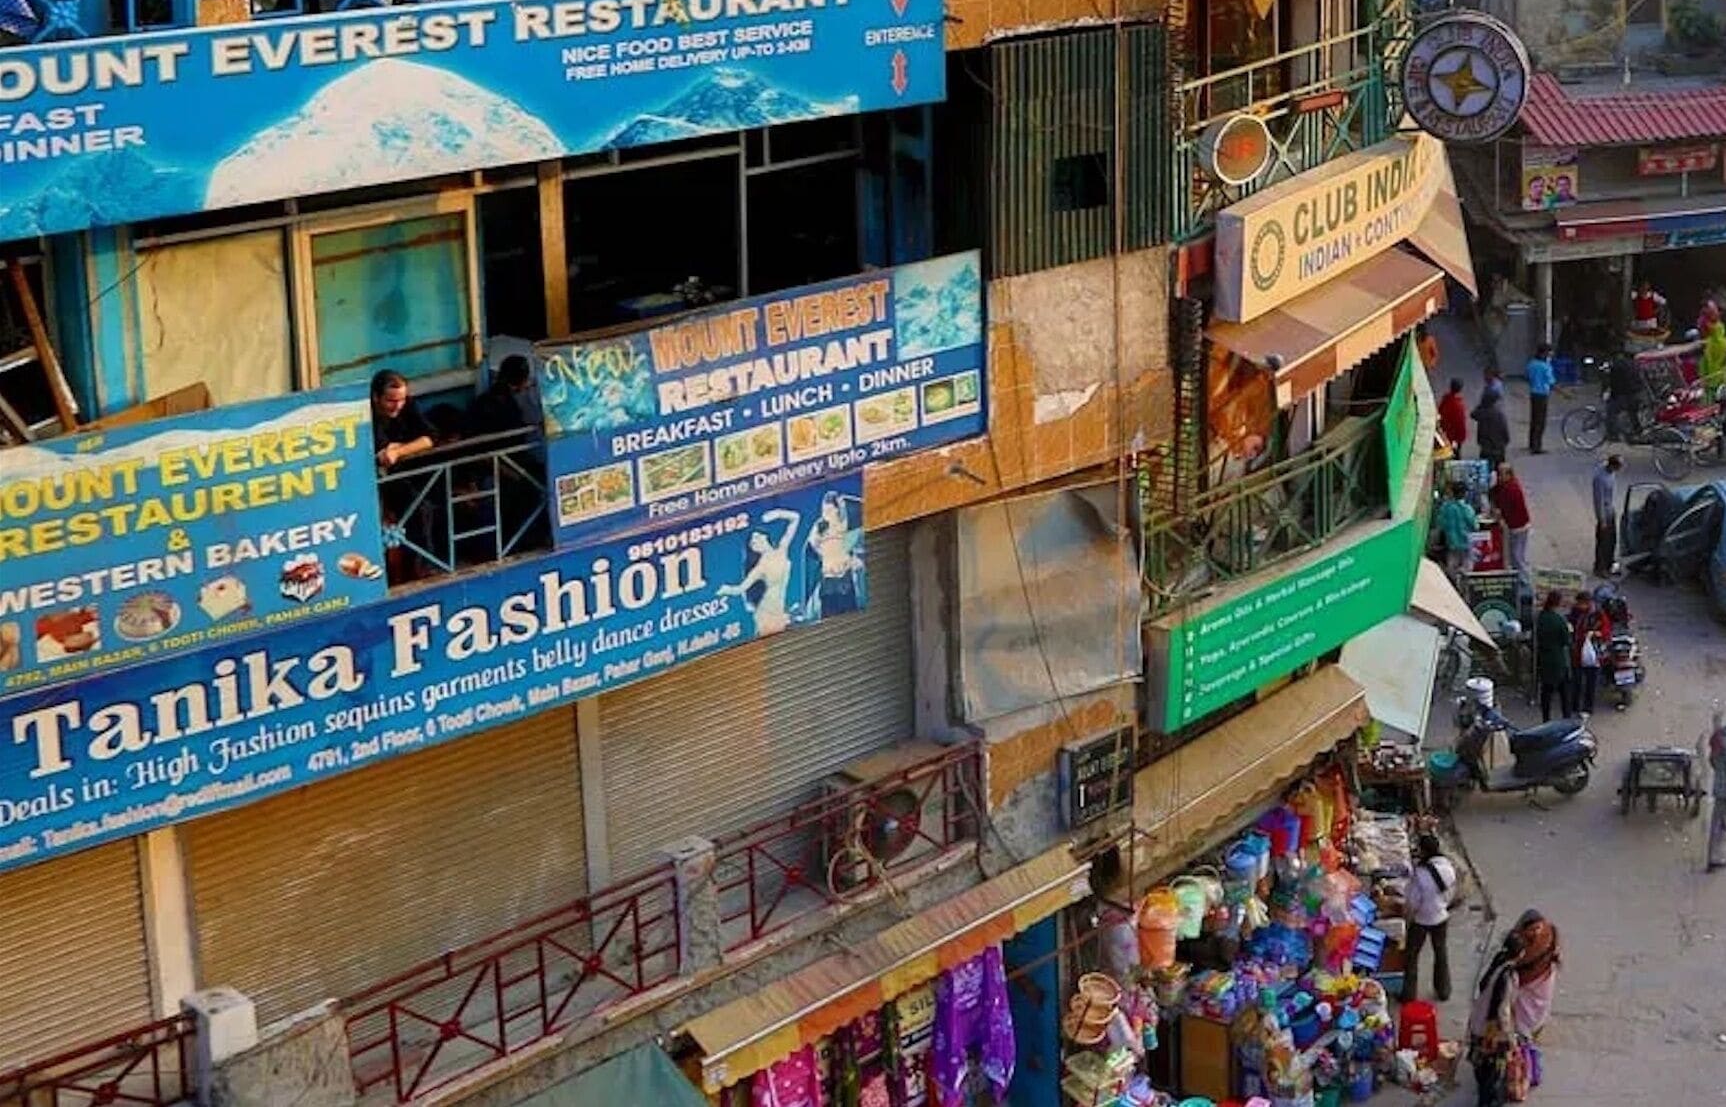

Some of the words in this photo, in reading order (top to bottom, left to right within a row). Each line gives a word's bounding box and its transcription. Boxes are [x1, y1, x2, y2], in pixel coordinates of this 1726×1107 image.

[211, 10, 497, 77] EVEREST
[562, 46, 610, 64] NICE
[617, 36, 670, 59] FOOD
[678, 31, 729, 52] BEST
[734, 21, 813, 45] SERVICE
[566, 64, 607, 82] FREE
[611, 58, 655, 77] HOME
[658, 50, 730, 72] DELIVERY
[0, 125, 146, 164] INNER
[1293, 179, 1358, 248] CLUB
[1299, 234, 1352, 281] INDIAN
[650, 307, 759, 374] MOUNT
[764, 280, 890, 347] EVEREST
[658, 328, 894, 417] RESTAURANT
[611, 408, 734, 458] BREAKFAST
[761, 384, 833, 418] LUNCH
[859, 358, 935, 392] DINNER
[160, 414, 364, 487] EVEREST
[648, 497, 690, 519] Free
[694, 481, 749, 508] Home
[753, 461, 824, 491] Delivery
[0, 550, 194, 617] WESTERN
[206, 513, 359, 570] BAKERY
[167, 528, 191, 552] &
[13, 642, 365, 781] Tanika
[387, 544, 707, 679] Fashion
[0, 783, 75, 826] Deals
[82, 776, 119, 803] in:
[126, 746, 199, 791] High
[208, 717, 318, 774] Fashion
[324, 689, 416, 733] sequins
[421, 659, 527, 712] garments
[532, 636, 588, 673] belly
[592, 619, 654, 655] dance
[659, 595, 730, 634] dresses
